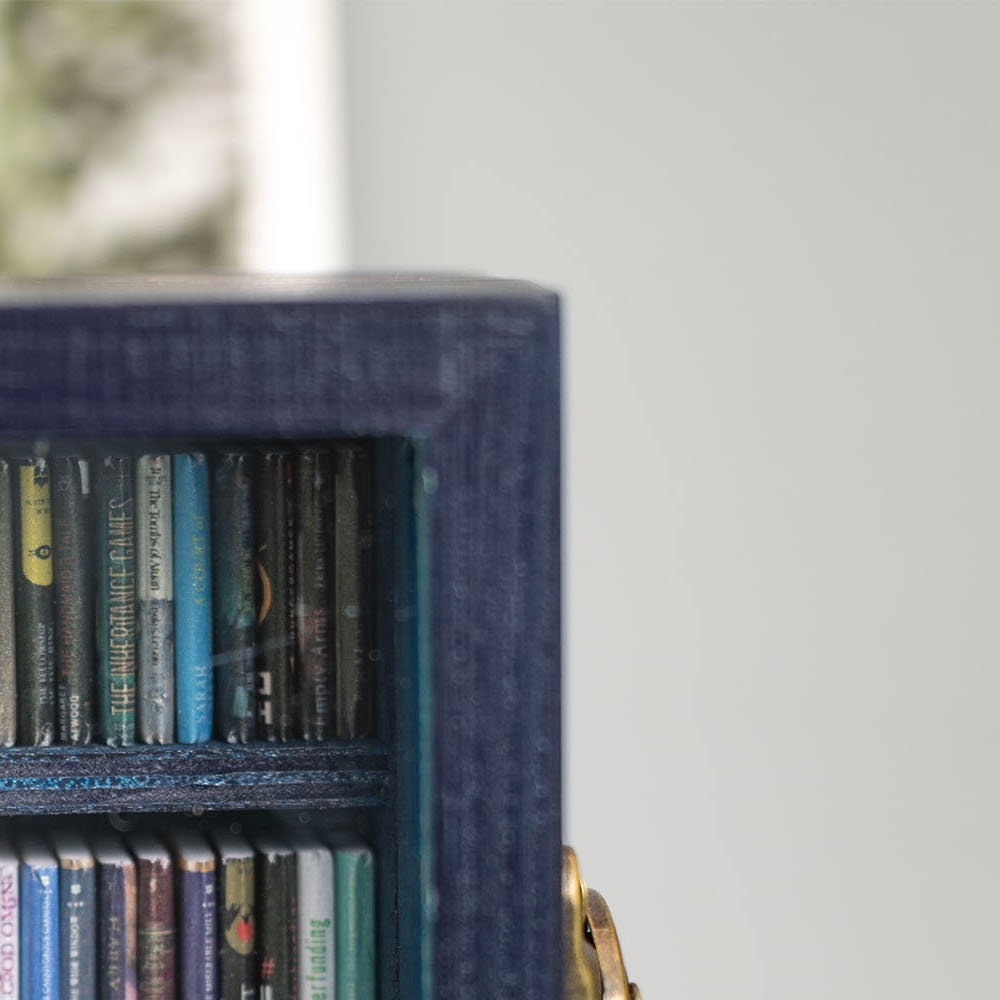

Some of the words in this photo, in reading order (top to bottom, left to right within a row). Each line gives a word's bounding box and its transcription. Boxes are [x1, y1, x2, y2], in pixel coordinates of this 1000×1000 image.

[149, 489, 161, 506] The
[108, 497, 134, 560] GAMES
[149, 508, 161, 546] Tombs
[149, 548, 161, 559] of
[193, 537, 205, 592] COURT
[149, 561, 161, 591] Atuan
[109, 567, 136, 676] INHERITANCE
[194, 597, 205, 606] A
[310, 608, 327, 657] Arms
[61, 645, 74, 675] THE
[59, 684, 68, 740] MARGARET
[110, 683, 135, 714] THE
[195, 665, 207, 725] SARAH
[70, 695, 80, 741] ATWOOD
[70, 916, 80, 958] WINDOW
[204, 912, 213, 935] MILL
[1, 942, 14, 996] GOOD
[70, 961, 80, 986] WIDE
[108, 915, 121, 992] HARRY
[204, 938, 213, 992] MISERABLE
